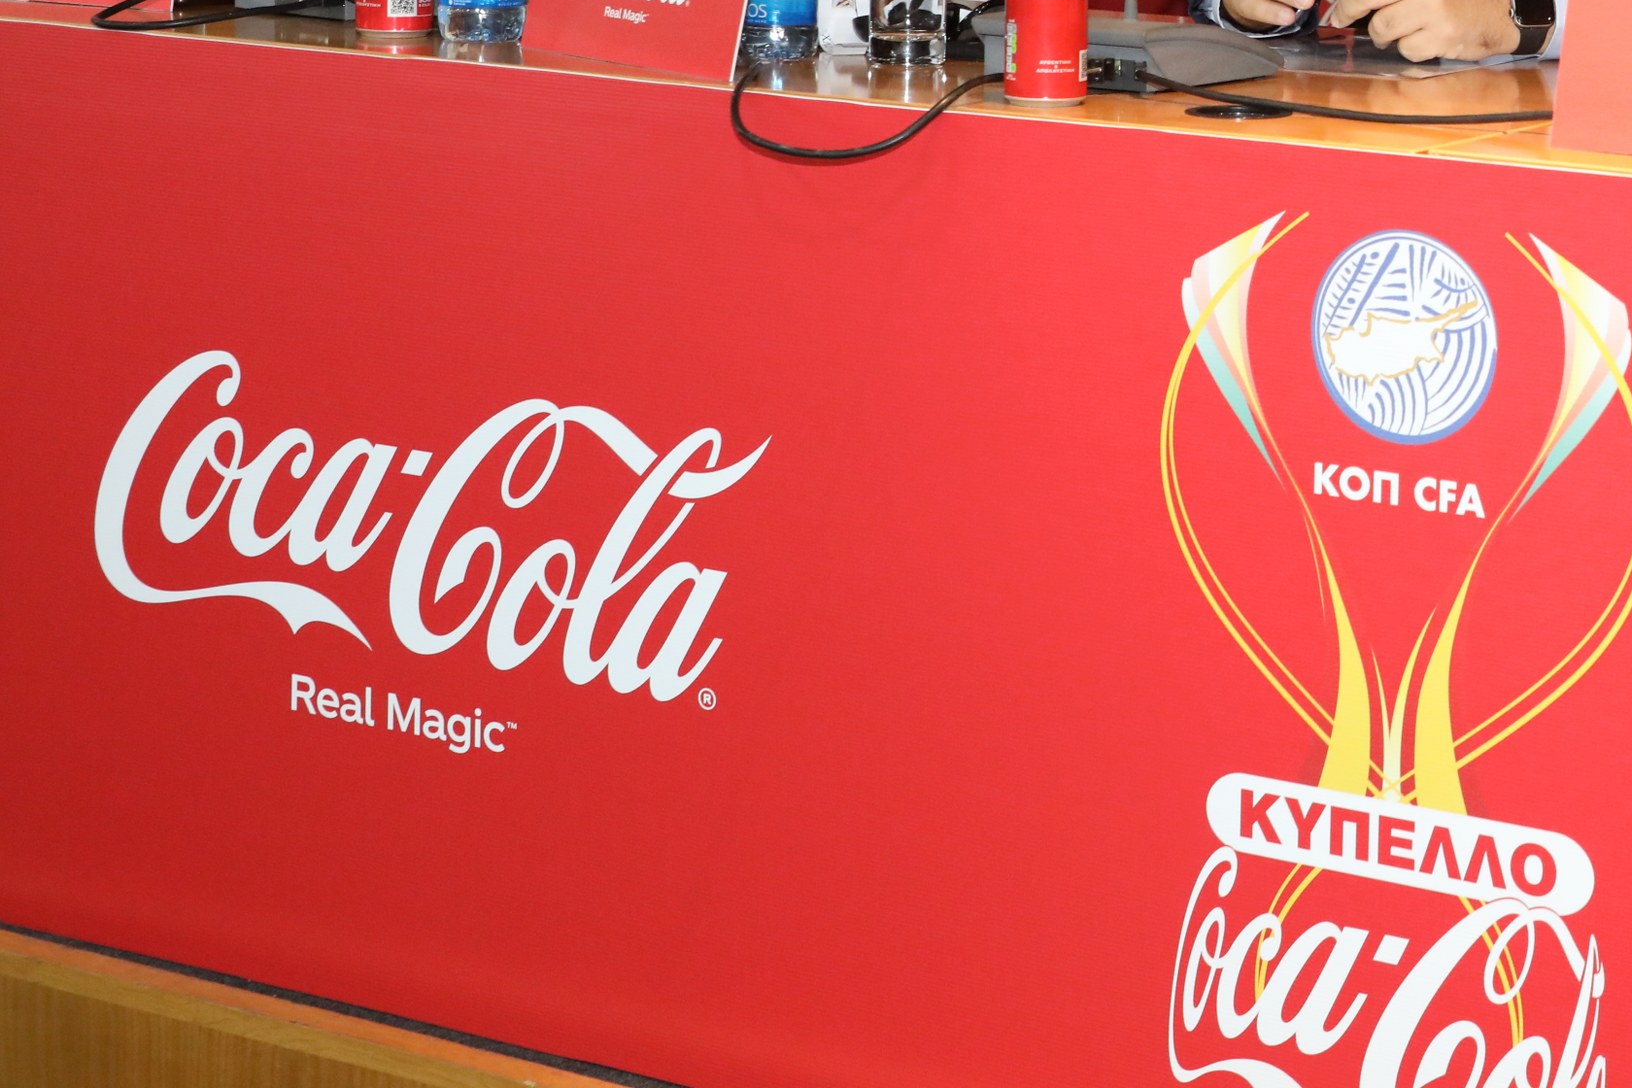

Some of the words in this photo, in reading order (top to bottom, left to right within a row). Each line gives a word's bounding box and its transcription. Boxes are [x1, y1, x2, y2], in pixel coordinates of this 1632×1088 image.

[603, 5, 623, 19] Real
[622, 8, 648, 24] Magic
[95, 350, 771, 703] Coca-Cola
[1313, 461, 1400, 506] ΚΟΠ
[1413, 476, 1486, 519] CFA
[290, 673, 375, 727] Real
[387, 691, 507, 755] Magic
[1239, 788, 1557, 896] ΚΥΠΕΛΛΟ
